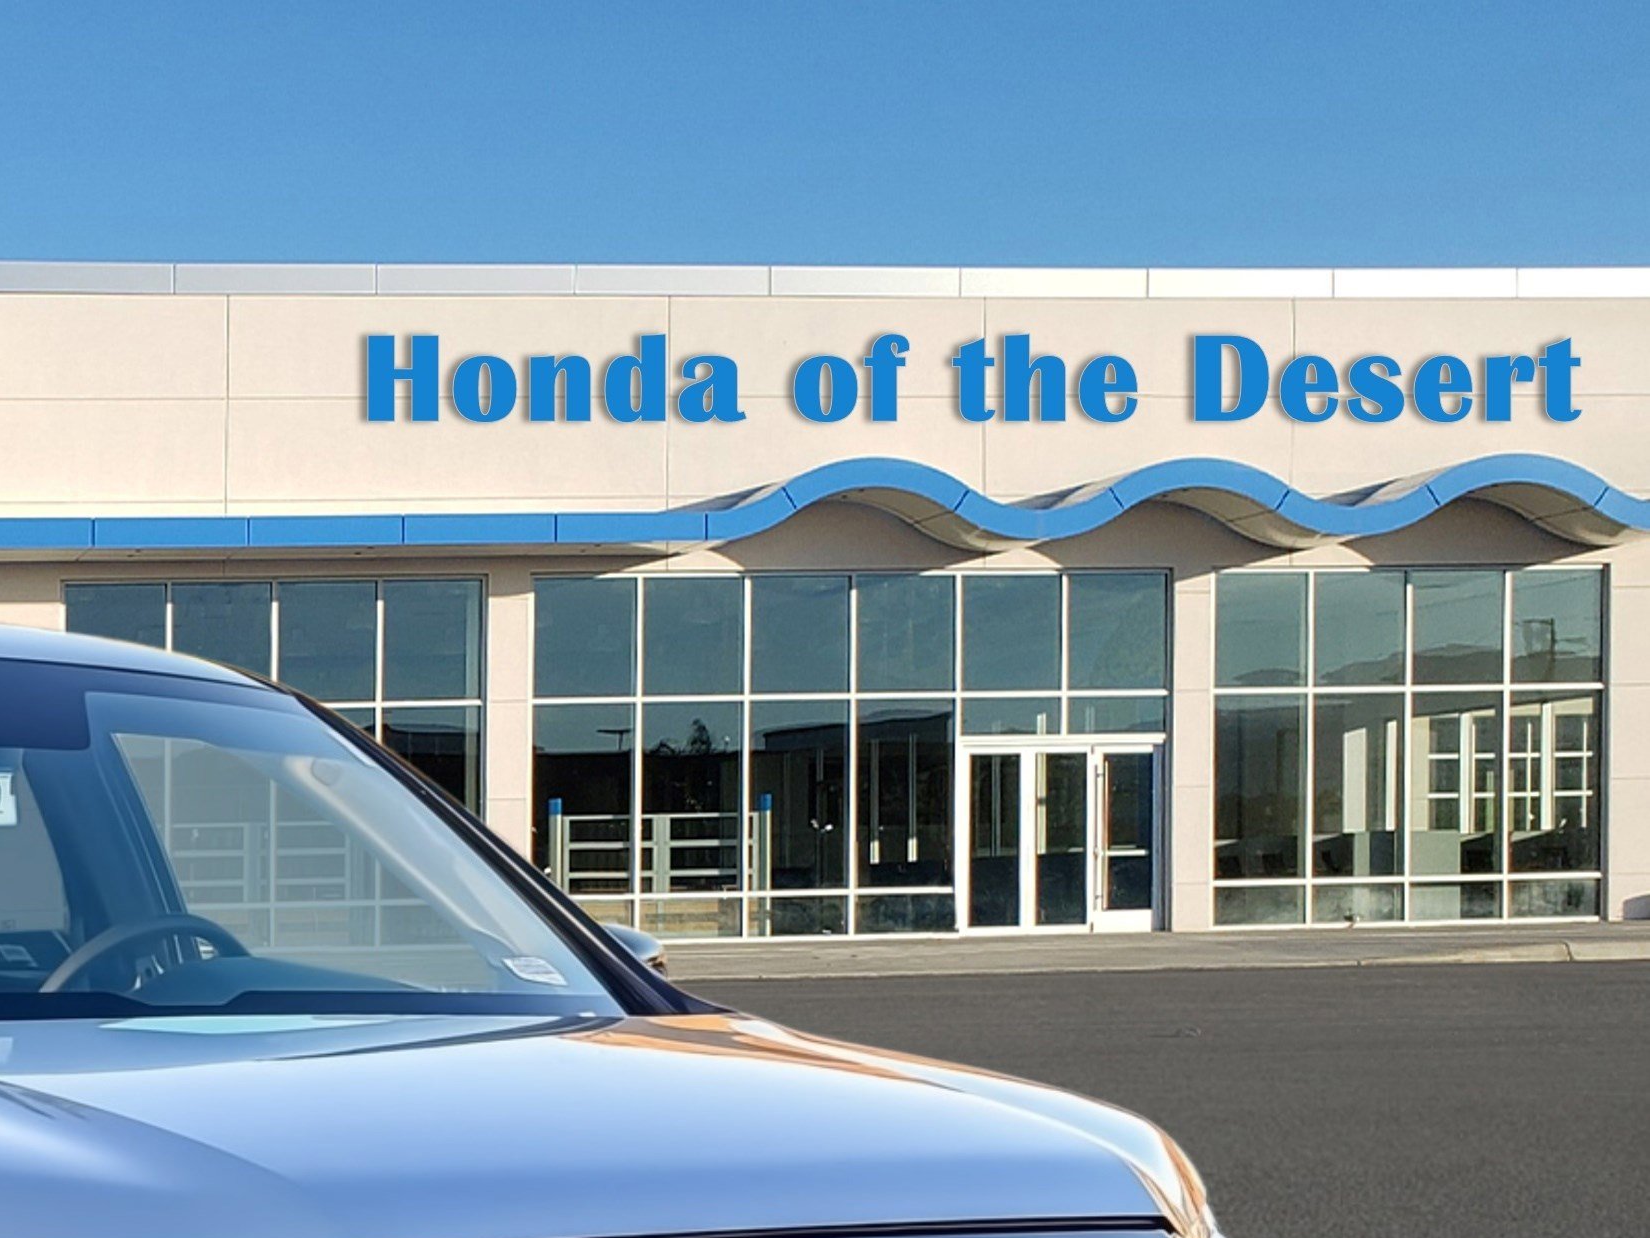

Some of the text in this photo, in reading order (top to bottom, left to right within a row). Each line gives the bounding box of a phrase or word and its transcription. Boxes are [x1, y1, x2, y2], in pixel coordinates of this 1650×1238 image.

[366, 333, 1583, 424] Honda of the Desert
